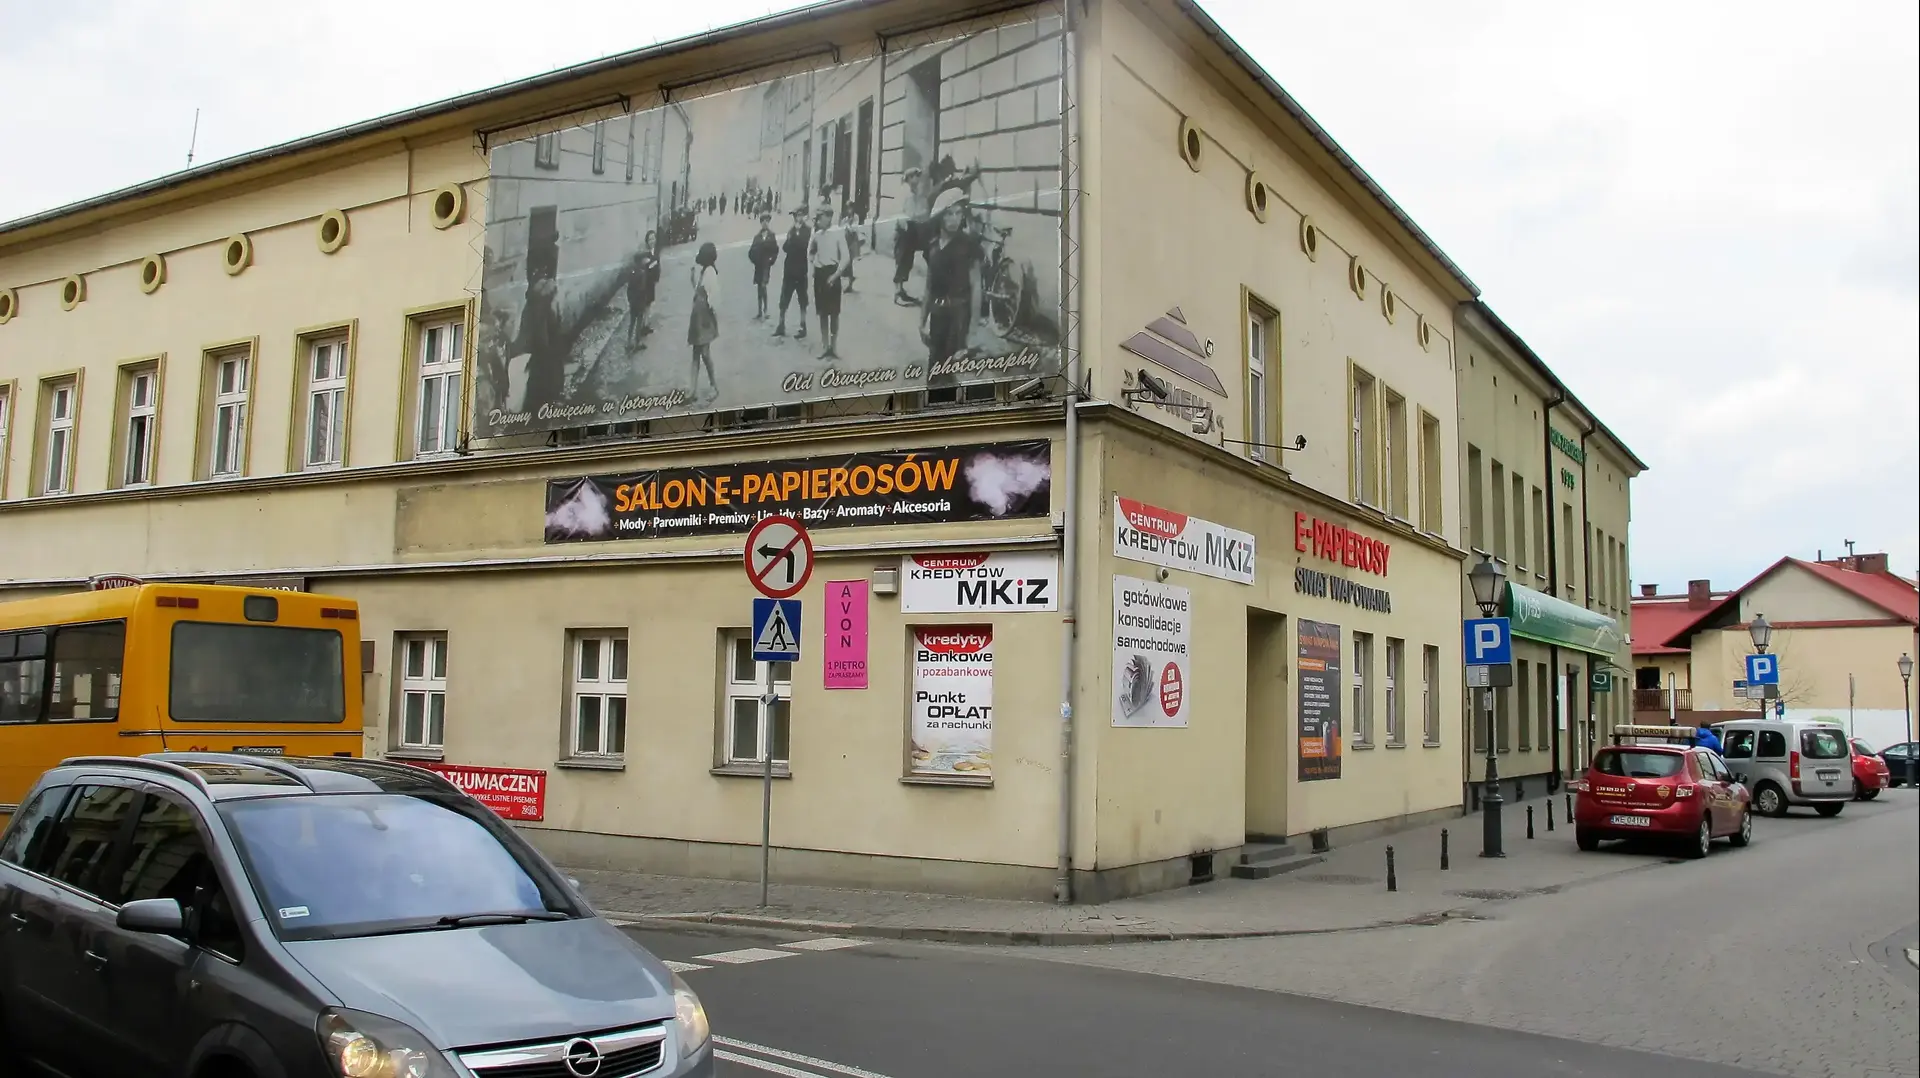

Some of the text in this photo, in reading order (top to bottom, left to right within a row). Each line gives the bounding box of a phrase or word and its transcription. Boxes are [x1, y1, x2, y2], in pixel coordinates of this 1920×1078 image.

[782, 347, 1040, 393] Old Oświęcim in photography
[488, 388, 686, 427] Dawny Oświęcim w fotografii
[614, 453, 960, 512] SALON E-PAPIEROSÓW
[619, 517, 647, 532] Mody
[653, 513, 702, 529] Parowniki
[708, 511, 750, 527] Premixy
[802, 506, 830, 521] Bazy
[836, 503, 886, 518] Aromaty
[892, 498, 951, 515] Akcesoria
[1130, 511, 1178, 535] CENTRUM
[1118, 526, 1252, 575] KREDYTÓW MKiZ
[1294, 511, 1390, 578] E-PAPIEROSY
[910, 564, 1005, 580] KREDYTÓW
[922, 559, 977, 568] CENTRUM
[957, 578, 1049, 606] MKiZ
[1294, 557, 1391, 614] ŚWIAT WAPOWANIA
[1123, 588, 1188, 612] gotówkowe
[840, 584, 852, 648] AVON
[1117, 609, 1182, 636] konsolidacje
[923, 632, 987, 649] kredyty
[1116, 636, 1187, 654] samochodowe
[1474, 623, 1501, 659] P
[827, 661, 866, 671] 1 PIĘTRO
[917, 649, 993, 662] Bankowe
[828, 671, 865, 679] ZAPRASZAMY
[916, 666, 993, 679] i pozabankowe
[1752, 657, 1771, 681] P
[916, 690, 966, 704] Punkt
[927, 705, 992, 719] OPŁAT
[941, 720, 992, 730] rachunki
[447, 771, 539, 793] TŁUMACZEN
[492, 795, 511, 803] USTNE
[513, 796, 537, 804] PISEMNE
